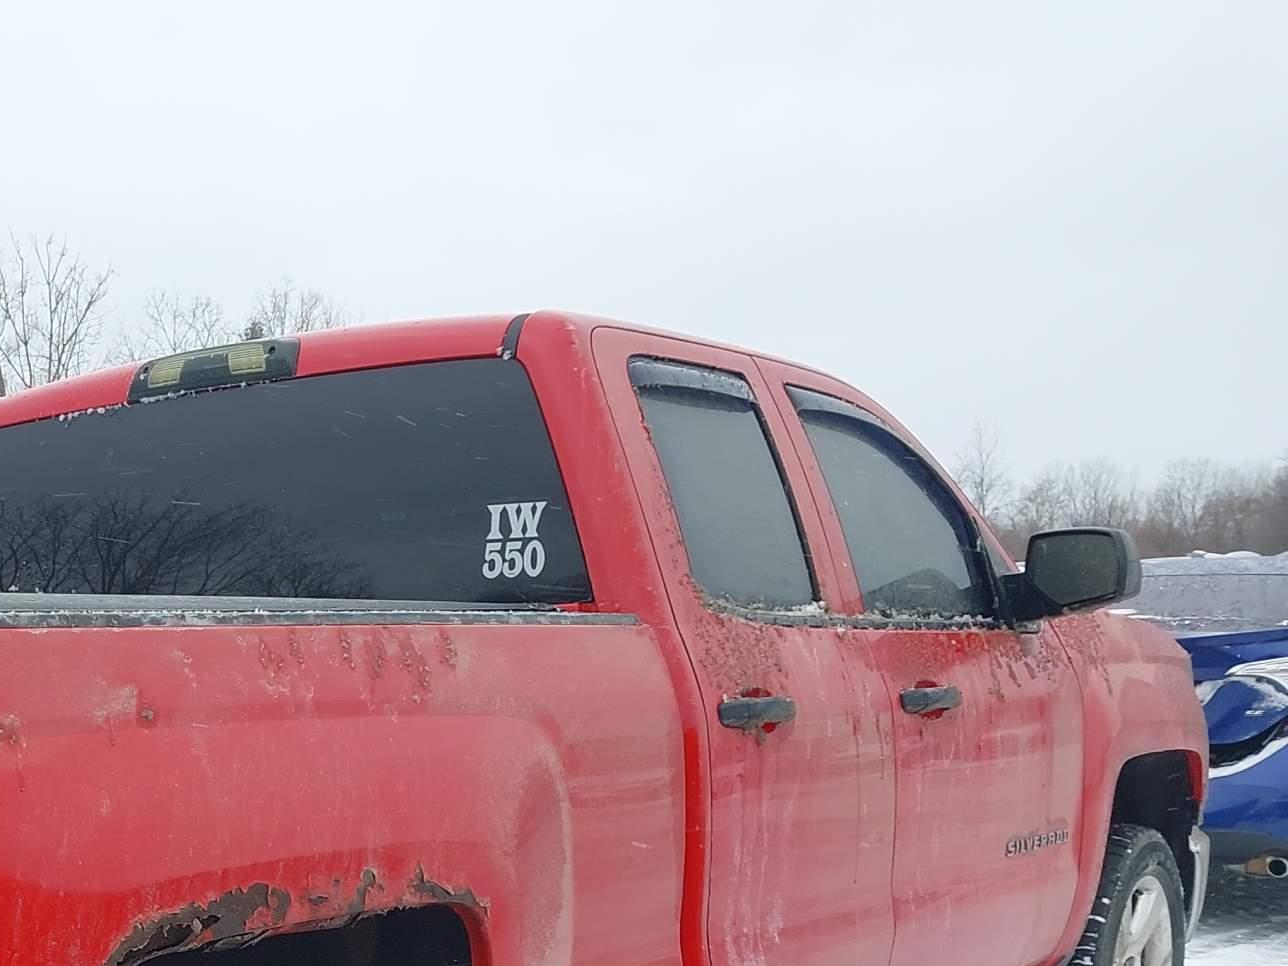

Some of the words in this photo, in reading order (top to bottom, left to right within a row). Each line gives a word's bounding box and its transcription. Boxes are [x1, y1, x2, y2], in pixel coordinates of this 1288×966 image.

[485, 501, 548, 541] IW
[482, 539, 546, 580] 550
[1005, 829, 1070, 857] SILVERADO
